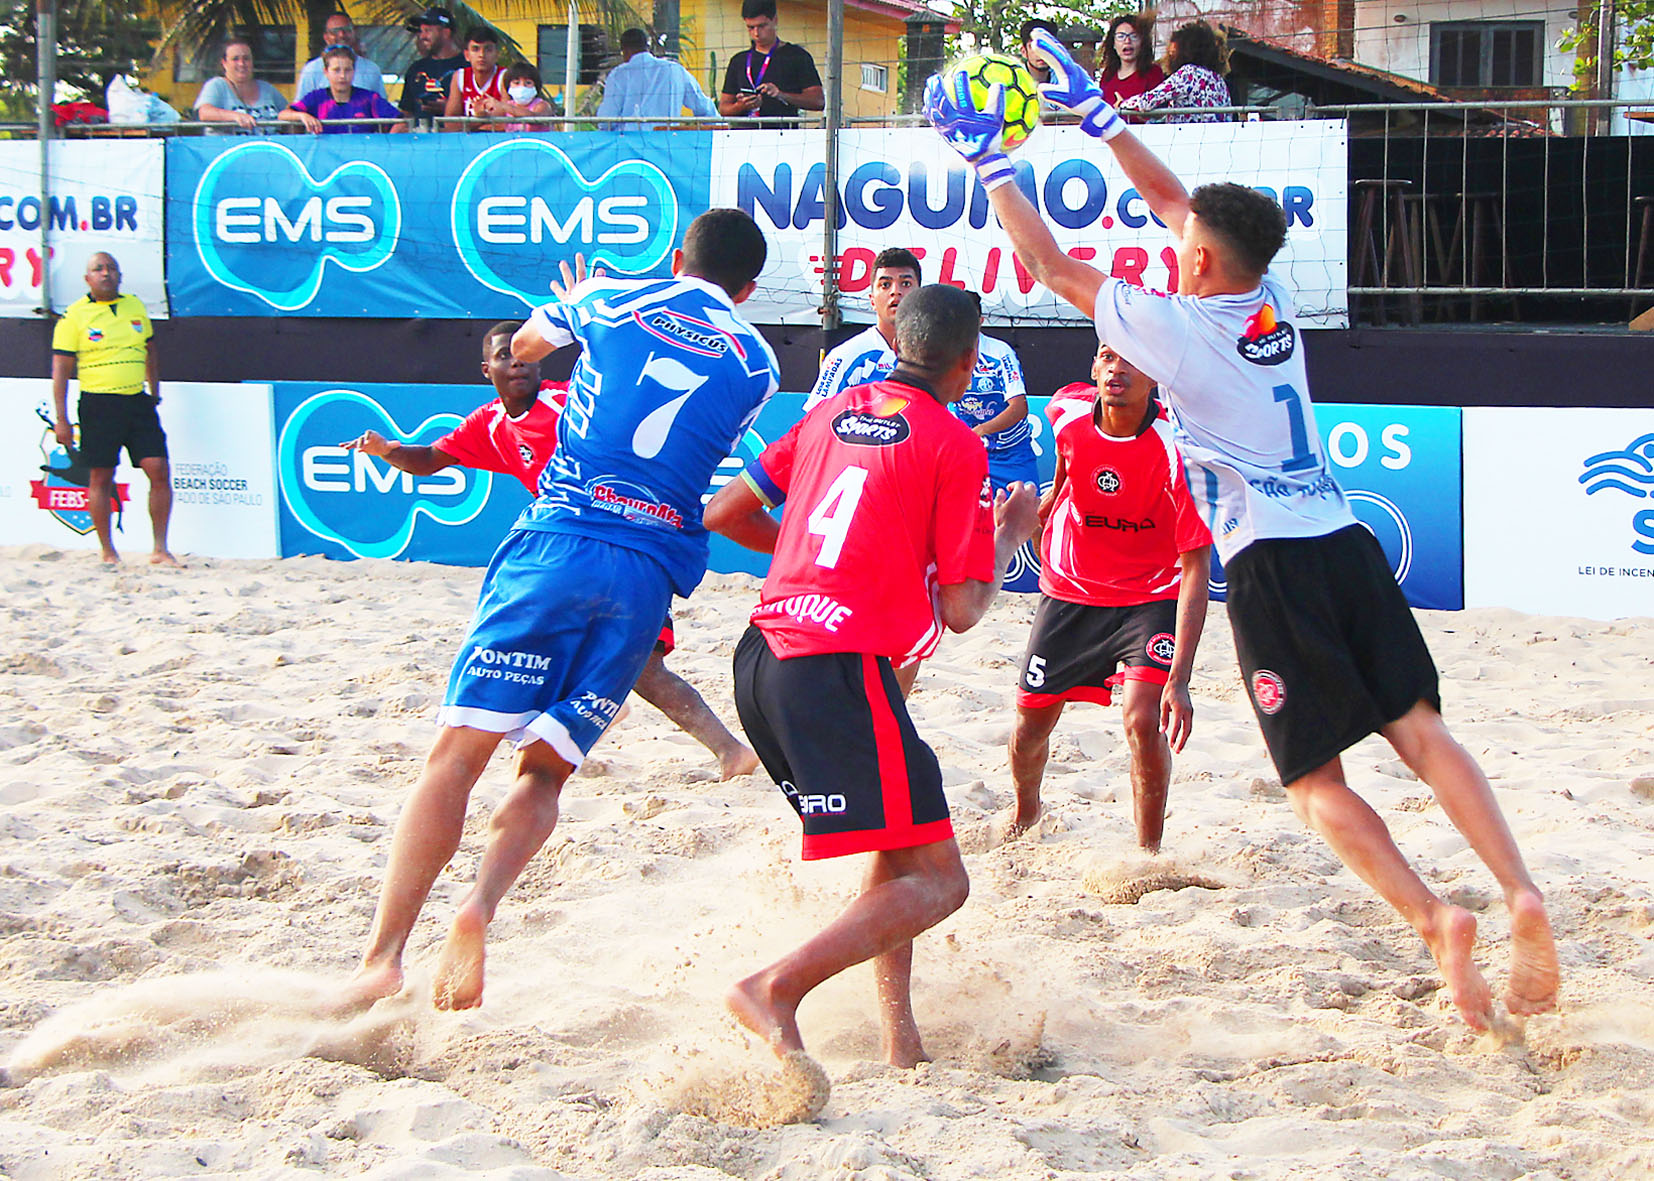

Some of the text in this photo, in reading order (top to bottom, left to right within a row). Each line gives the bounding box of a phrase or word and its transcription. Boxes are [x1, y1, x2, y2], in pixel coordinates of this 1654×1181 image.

[216, 197, 375, 243] EMS
[477, 196, 649, 244] EMS
[652, 316, 729, 353] PHYSICUS
[632, 351, 709, 459] 7
[836, 415, 898, 440] SPORTS
[1272, 383, 1319, 472] 1
[174, 477, 248, 491] BEACH SOCCER
[807, 464, 869, 569] 4
[1578, 566, 1596, 576] LEI
[1599, 567, 1616, 577] DE
[467, 666, 545, 686] AUTO PEÇAS
[1026, 654, 1046, 687] 5
